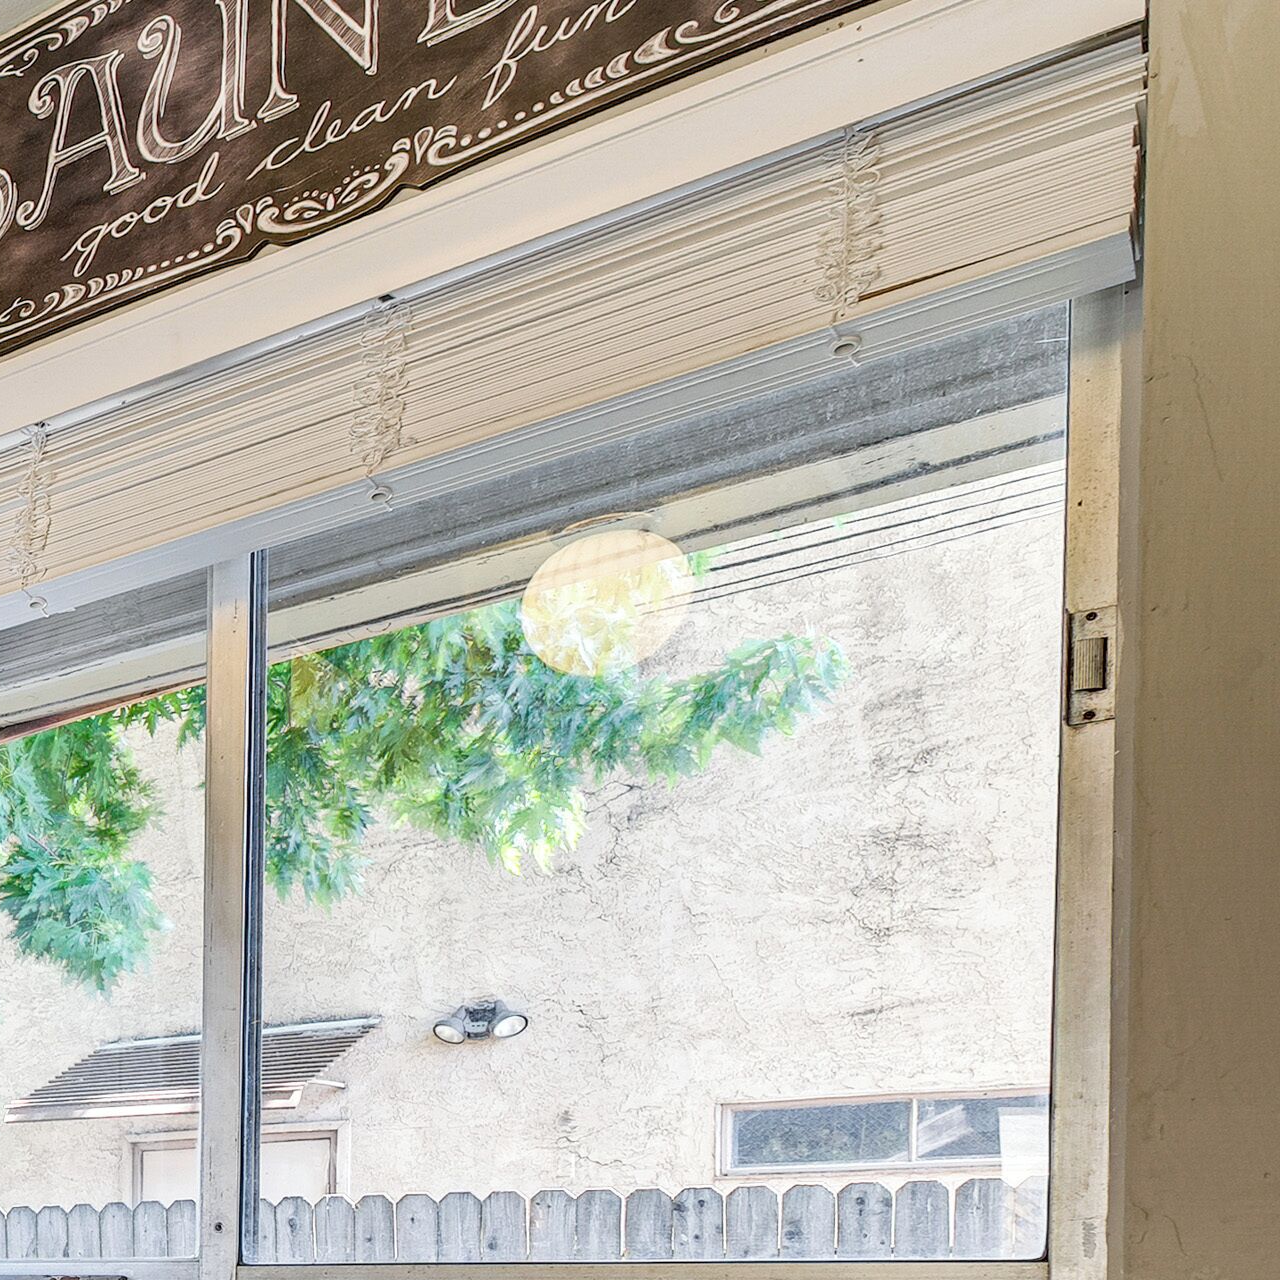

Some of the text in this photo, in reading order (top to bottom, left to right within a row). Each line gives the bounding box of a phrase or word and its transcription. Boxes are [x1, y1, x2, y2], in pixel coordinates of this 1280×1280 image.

[60, 0, 638, 278] good clean fun
